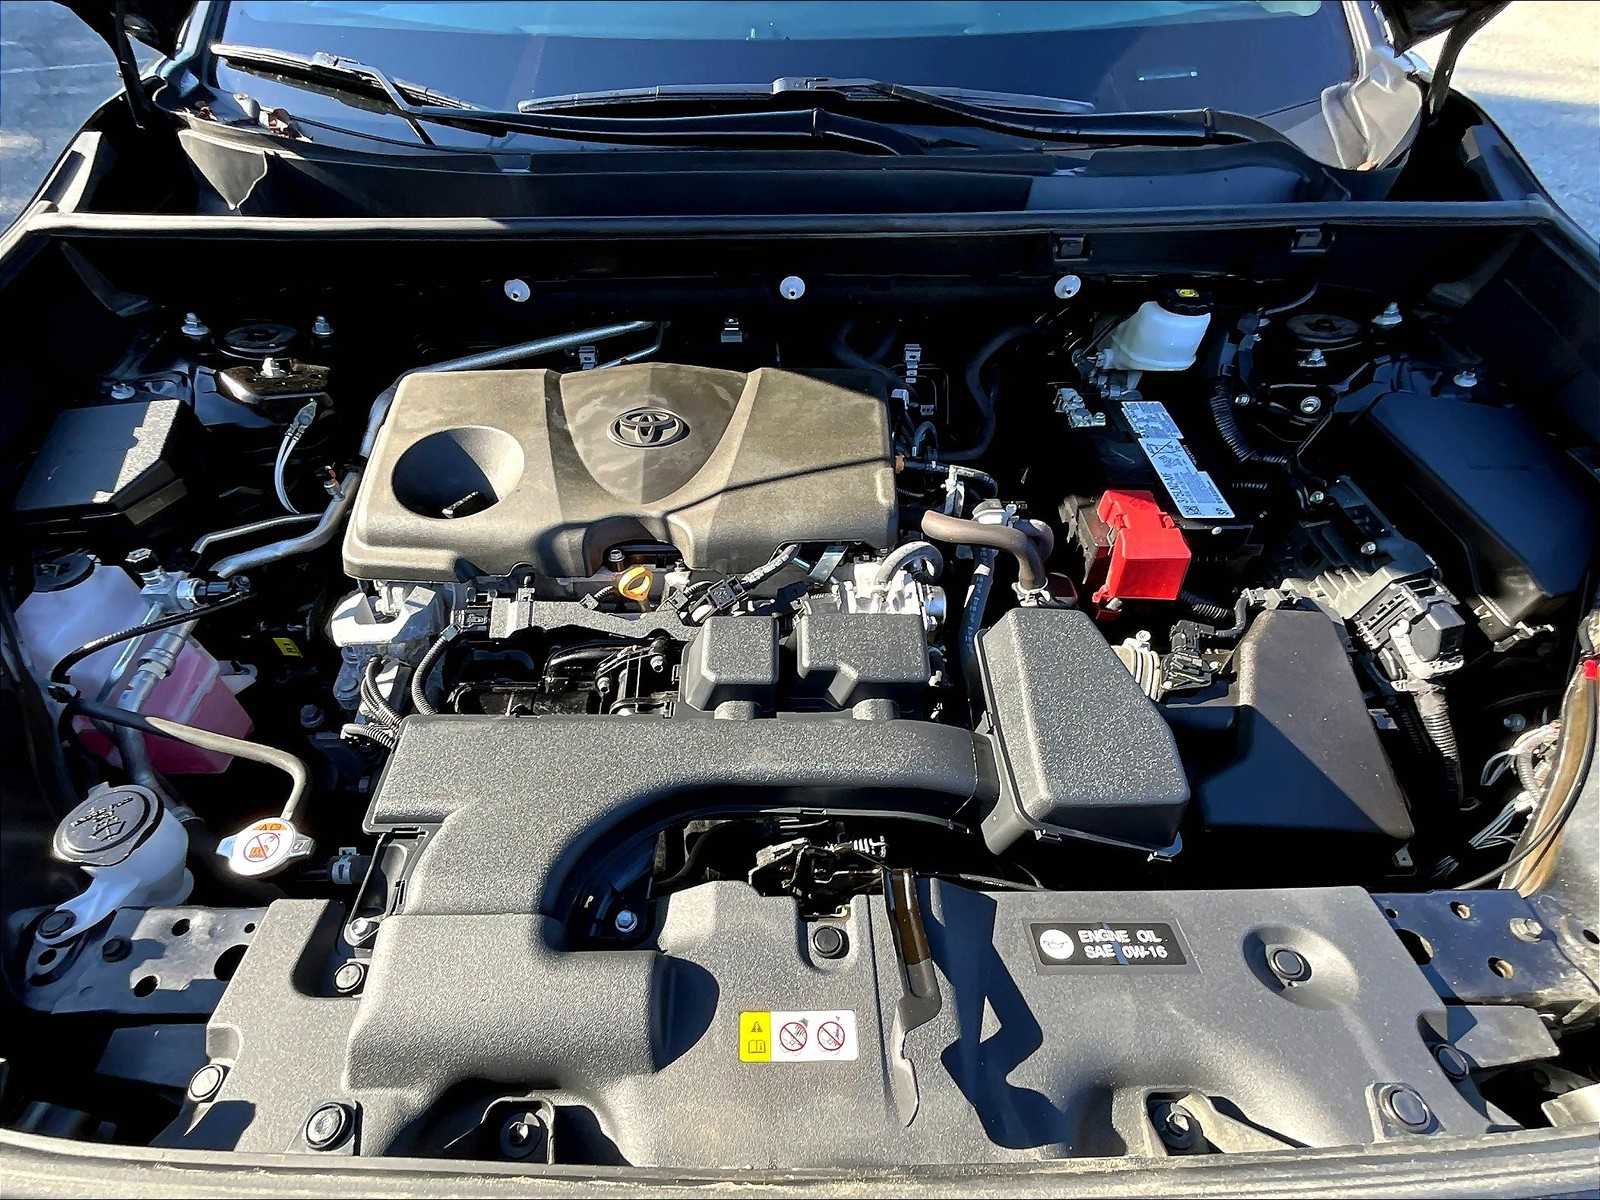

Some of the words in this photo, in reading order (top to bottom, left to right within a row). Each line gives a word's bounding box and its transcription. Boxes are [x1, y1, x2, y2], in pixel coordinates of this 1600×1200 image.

[1077, 929, 1131, 943] ENGINE
[1136, 929, 1162, 943] OIL
[1083, 944, 1116, 959] SAE
[1121, 944, 1168, 959] 0W-16
